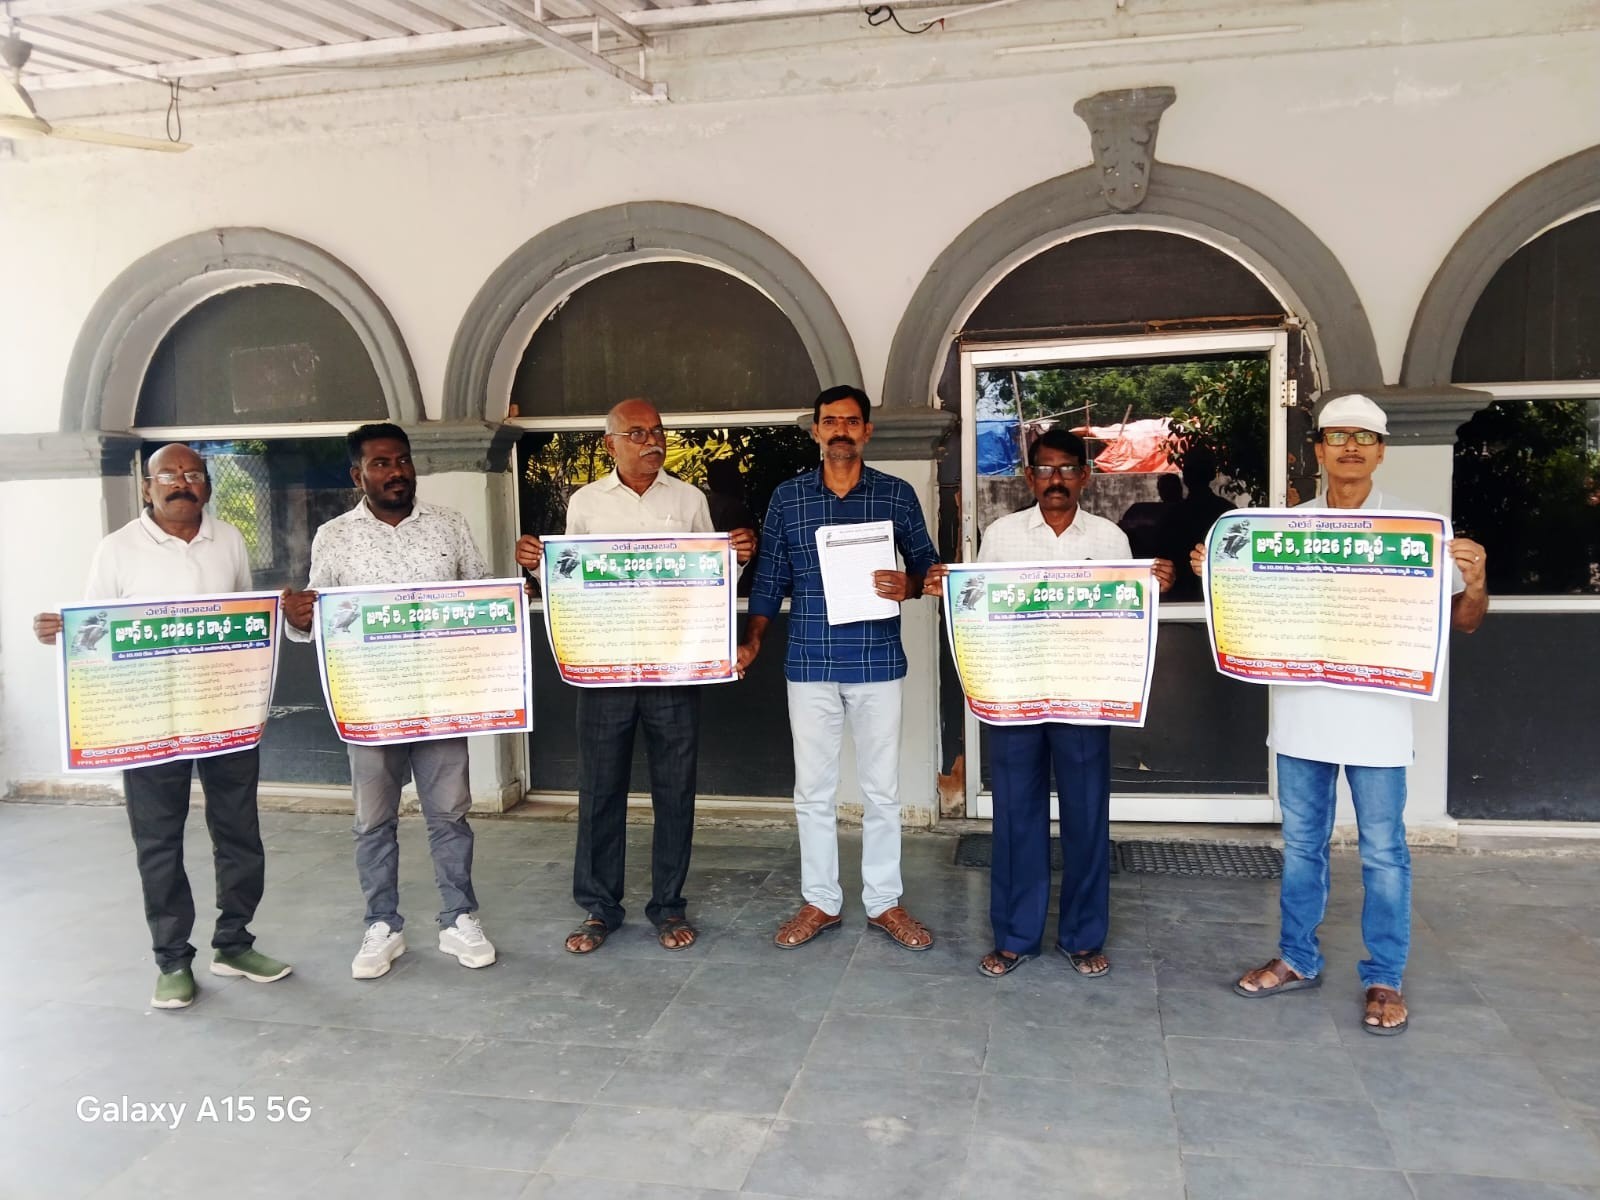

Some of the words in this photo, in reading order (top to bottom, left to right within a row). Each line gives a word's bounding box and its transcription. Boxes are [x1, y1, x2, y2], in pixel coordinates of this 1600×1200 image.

[1256, 532, 1283, 558] జూన్
[1303, 538, 1340, 554] 2026
[624, 558, 653, 571] 2026
[1033, 588, 1064, 602] 2026
[366, 606, 390, 627] జూన్
[409, 608, 440, 623] 2026
[115, 620, 141, 644] జూన్
[161, 623, 193, 638] 2026
